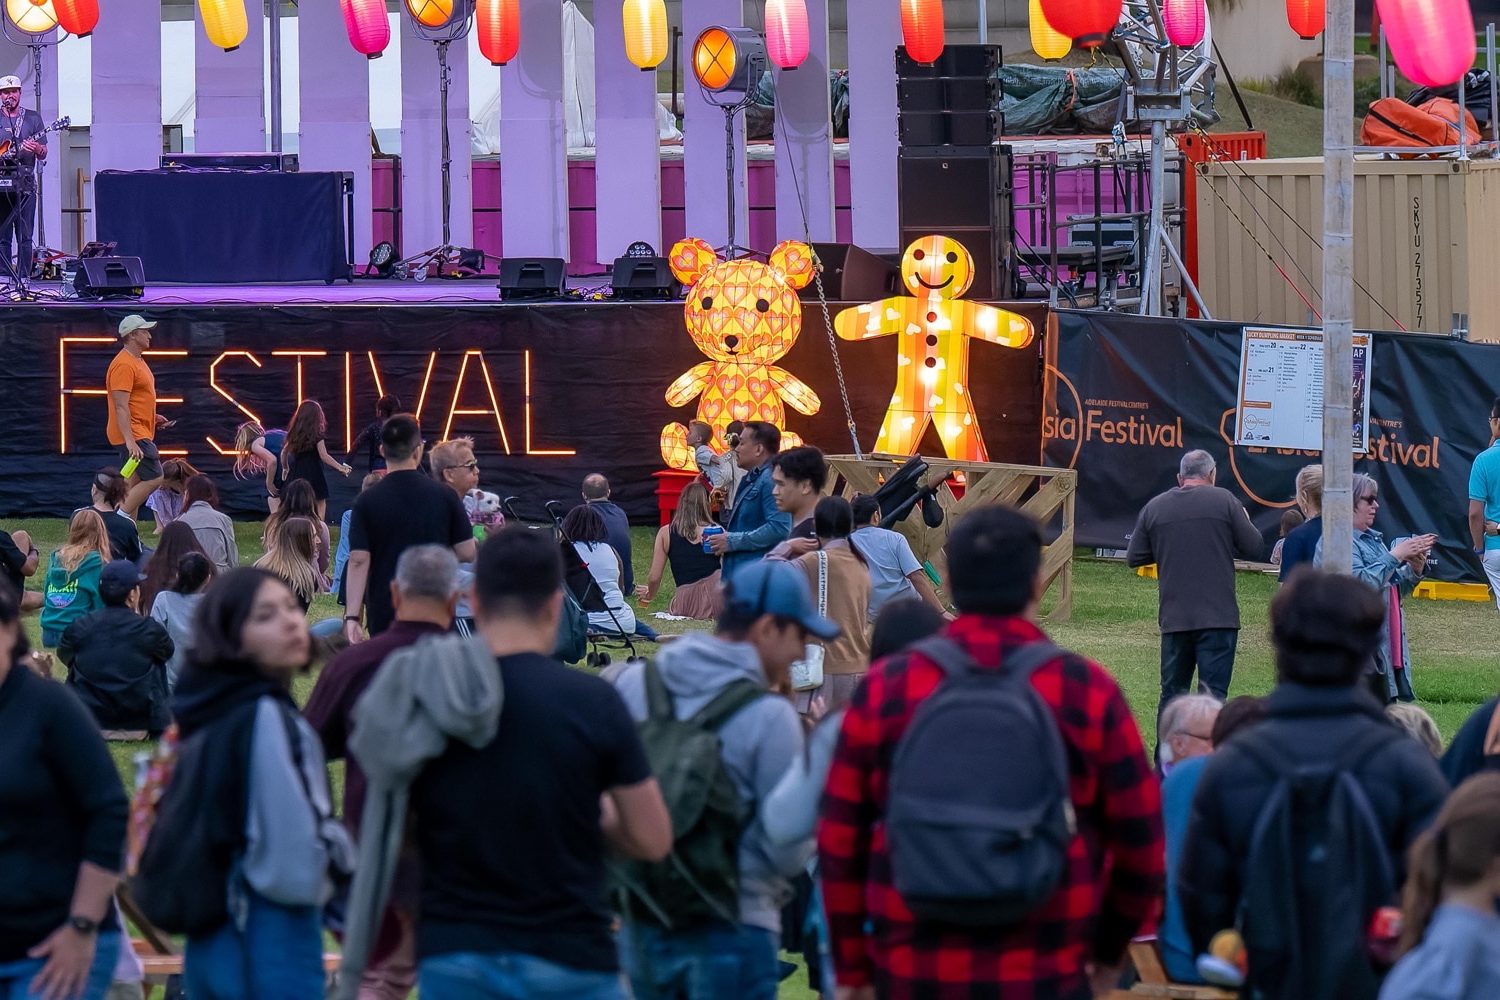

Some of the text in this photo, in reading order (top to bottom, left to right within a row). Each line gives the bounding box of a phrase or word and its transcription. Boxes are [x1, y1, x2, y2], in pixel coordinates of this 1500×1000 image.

[1413, 196, 1423, 329] SKYU 273577
[1353, 348, 1364, 358] AP
[59, 337, 577, 456] FESTIVAL
[1044, 408, 1184, 449] sia Festival
[1353, 433, 1440, 469] stival
